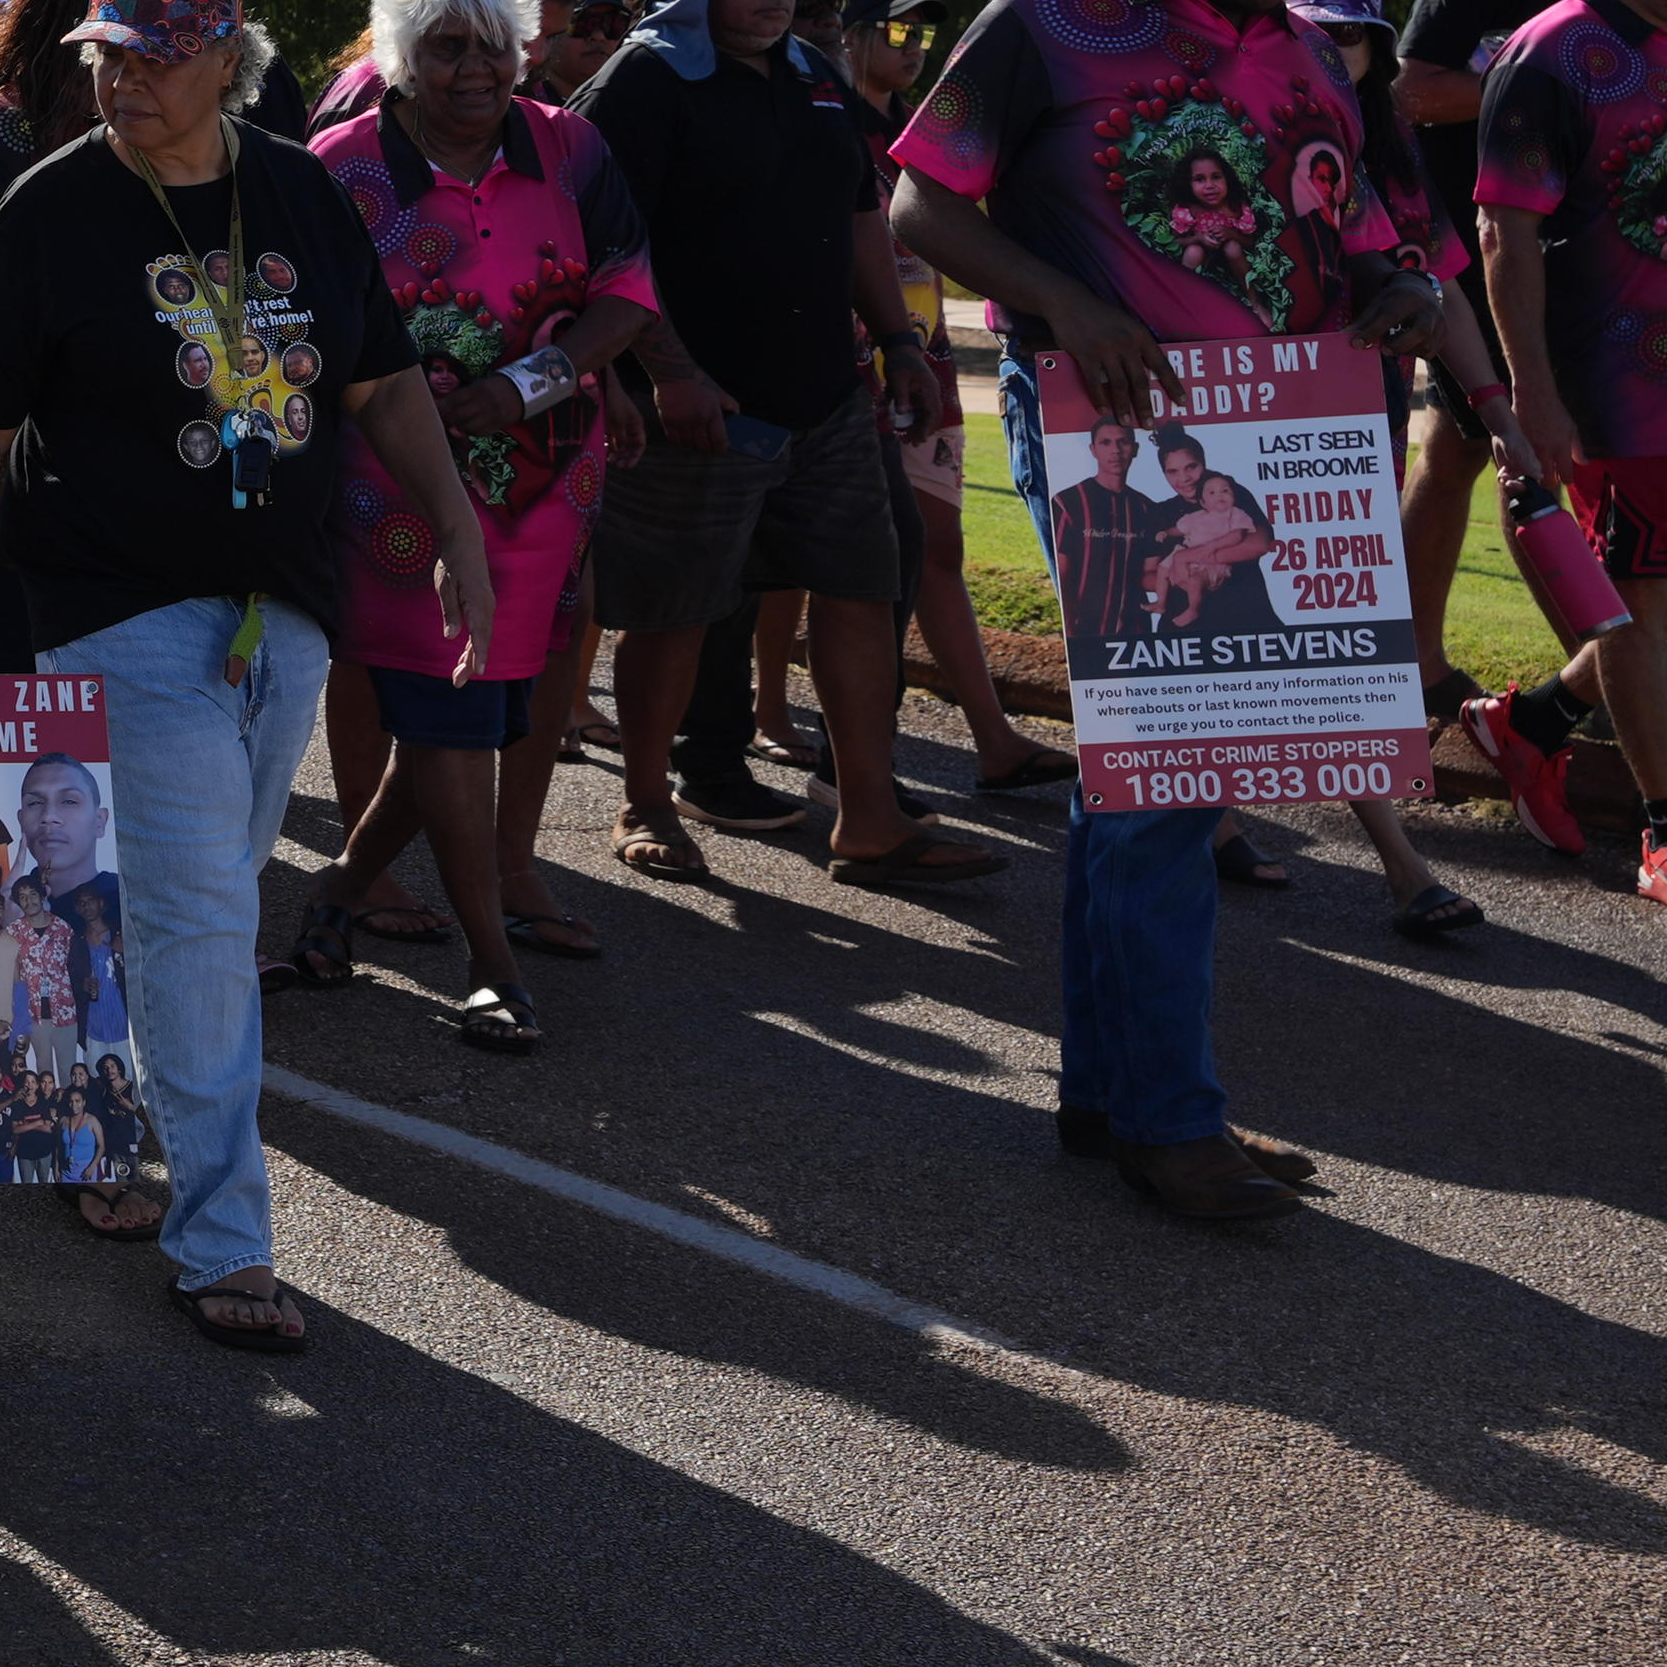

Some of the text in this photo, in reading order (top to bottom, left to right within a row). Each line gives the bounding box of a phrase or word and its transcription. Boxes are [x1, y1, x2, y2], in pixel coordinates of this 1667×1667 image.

[155, 311, 179, 324] Our
[265, 296, 292, 312] rest
[186, 320, 217, 335] until
[270, 309, 315, 326] home!
[1222, 344, 1255, 375] IS
[1272, 341, 1319, 372] MY
[1259, 429, 1375, 454] LAST SEEN
[1257, 456, 1380, 481] IN BROOME
[1265, 488, 1372, 526] FRIDAY
[1270, 533, 1393, 572] 26 APRIL
[1293, 570, 1378, 611] 2024
[1105, 628, 1378, 671] ZANE STEVENS
[15, 680, 96, 712] ZANE
[1084, 671, 1409, 702] If you have seen or heard any information on his
[1097, 691, 1396, 717] whereabouts or last known movements then
[1136, 711, 1365, 734] we urge you to contact the police.
[1103, 738, 1400, 770] CONTACT CRIME STOPPERS
[1125, 762, 1391, 806] 1800 333 000
